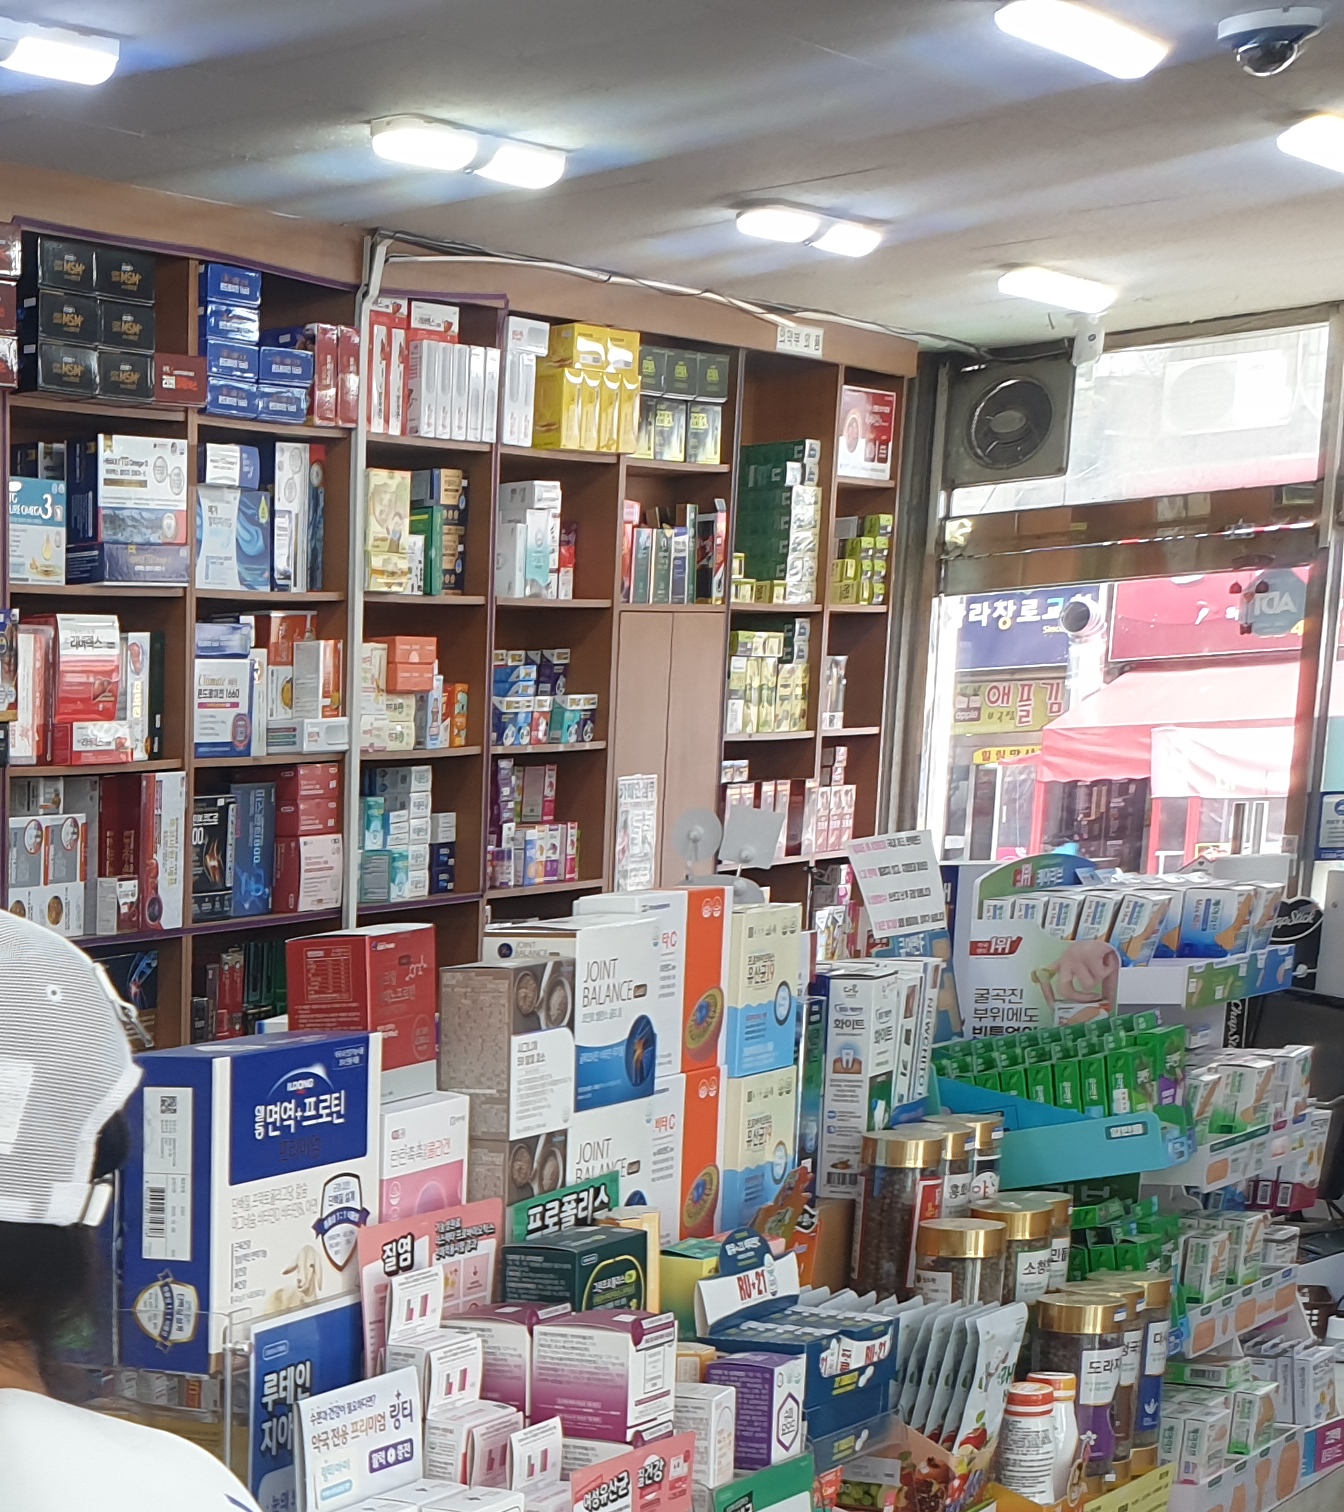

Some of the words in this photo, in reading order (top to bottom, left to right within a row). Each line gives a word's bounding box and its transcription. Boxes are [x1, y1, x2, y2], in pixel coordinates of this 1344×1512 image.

[583, 957, 619, 983] JOINT
[582, 980, 634, 1008] BALANCE
[974, 987, 1024, 1004] 굴곡진
[973, 1006, 1040, 1024] 부위에도
[525, 1184, 611, 1232] 프로폴리스
[382, 1233, 415, 1276] 질염
[261, 1360, 312, 1412] 루테인
[389, 1399, 414, 1431] 링티
[311, 1431, 330, 1454] 약국
[330, 1425, 349, 1448] 전용
[350, 1414, 388, 1439] 프리미엄
